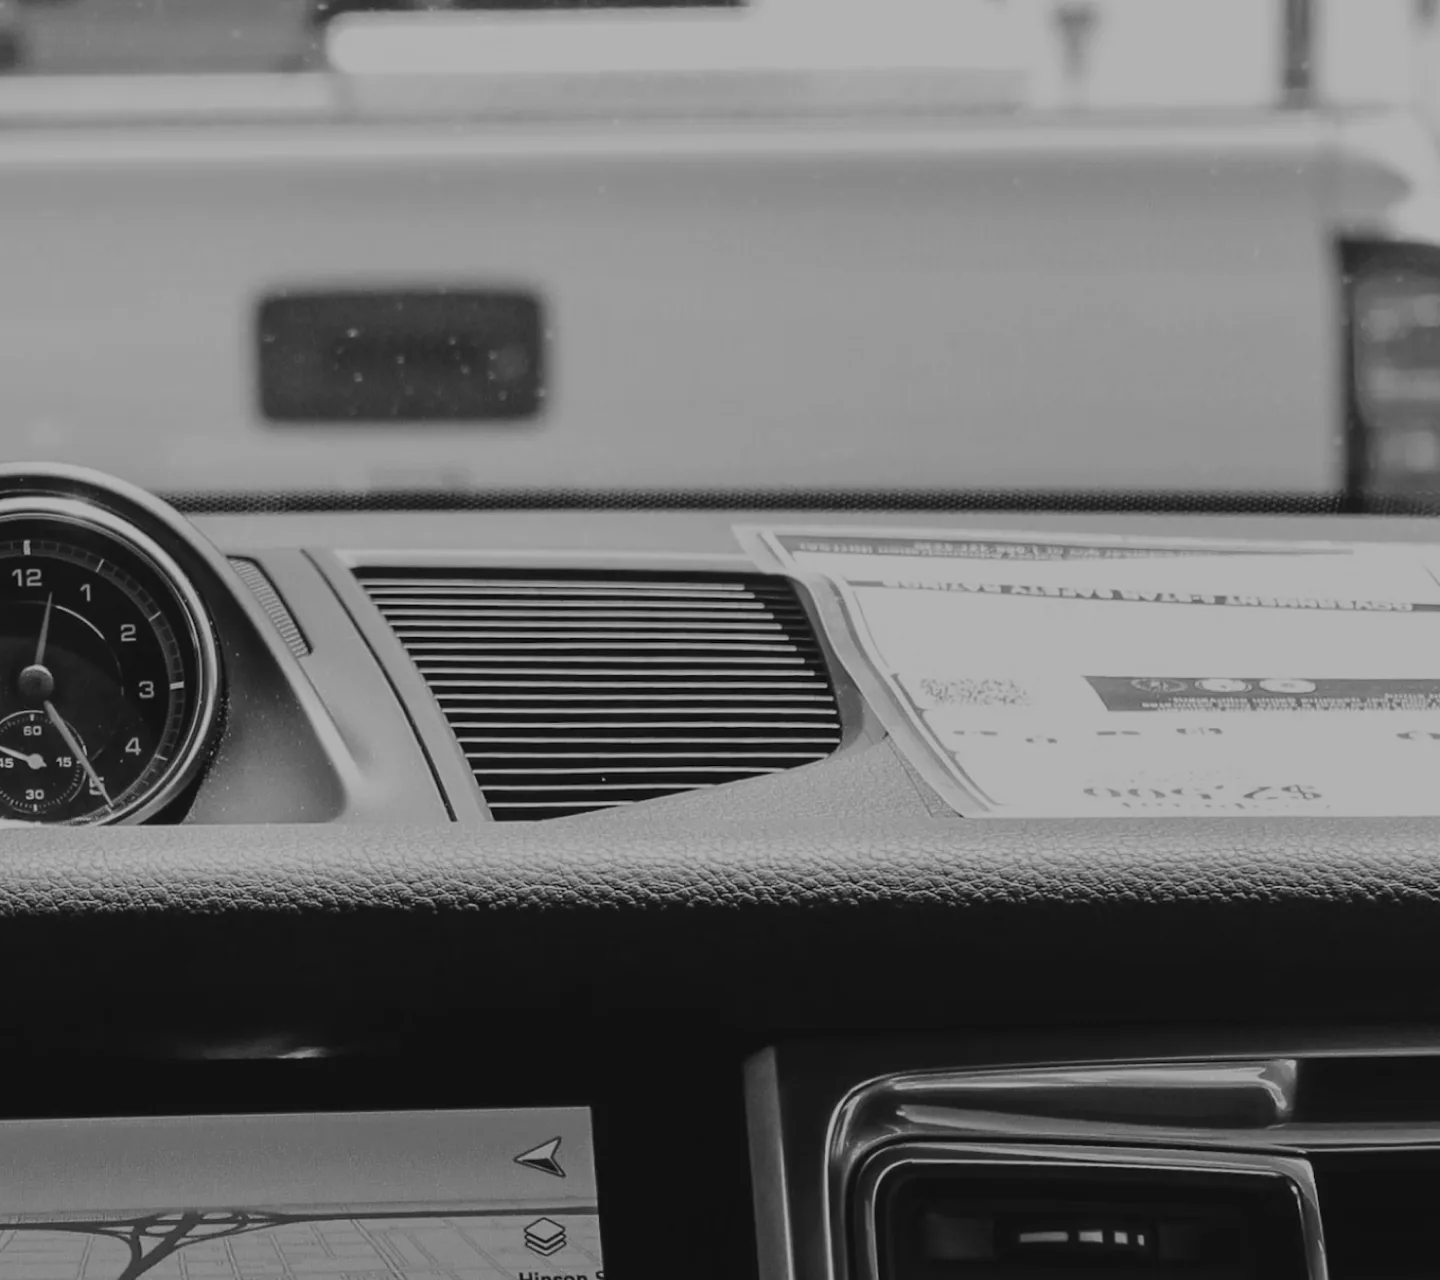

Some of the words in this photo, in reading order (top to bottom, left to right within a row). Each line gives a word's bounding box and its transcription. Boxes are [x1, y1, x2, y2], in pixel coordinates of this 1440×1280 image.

[12, 569, 42, 587] 12
[80, 584, 91, 601] 1
[120, 624, 137, 641] 2
[139, 681, 154, 699] 3
[23, 726, 42, 736] 60
[125, 738, 141, 755] 4
[56, 757, 72, 768] 15
[26, 789, 45, 800] 30
